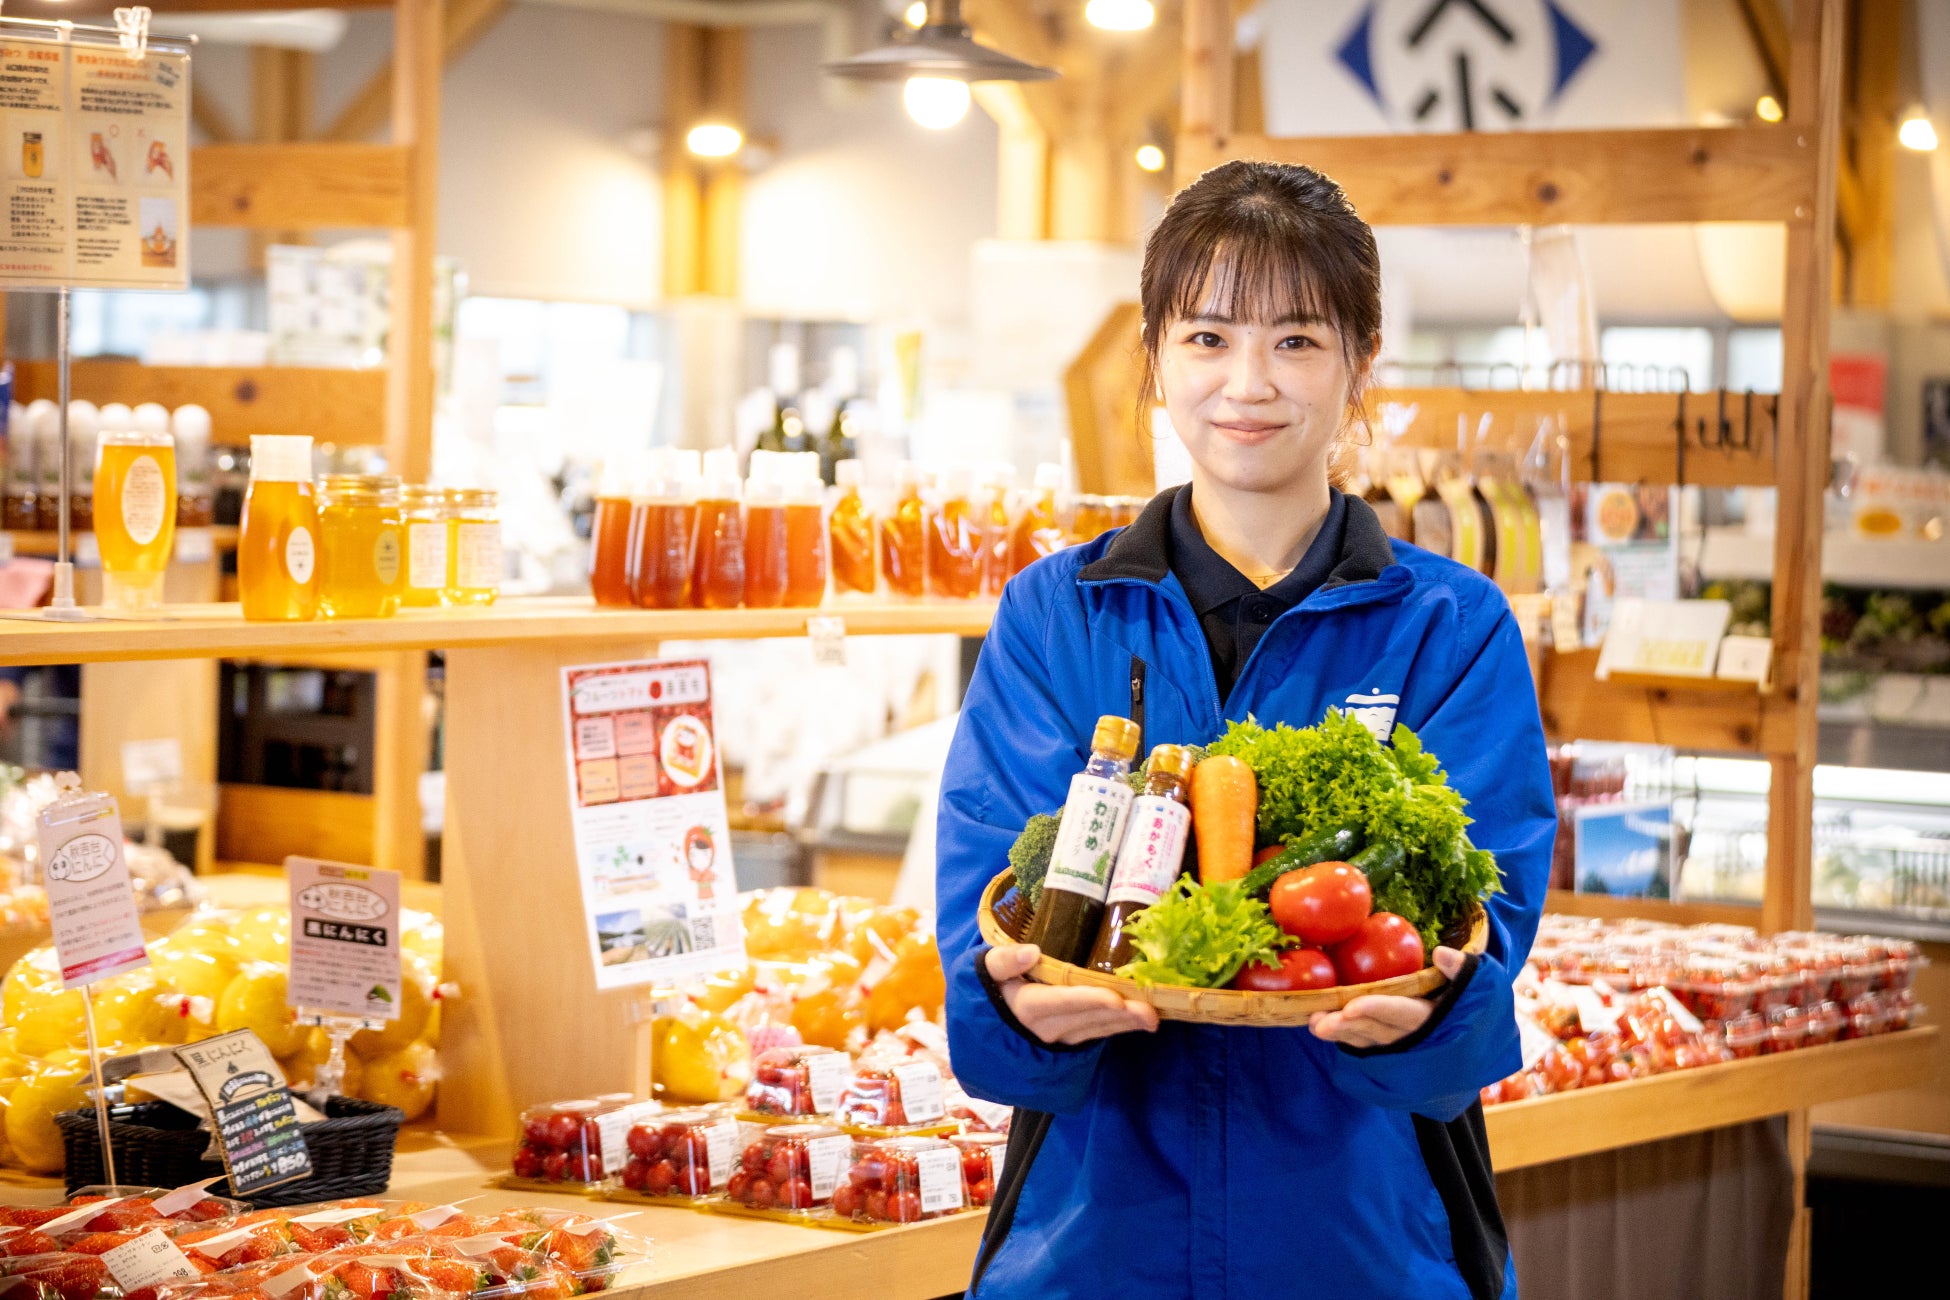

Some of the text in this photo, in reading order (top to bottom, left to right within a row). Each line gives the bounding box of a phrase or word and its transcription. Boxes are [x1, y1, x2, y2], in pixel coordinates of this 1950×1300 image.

[1084, 800, 1109, 851] わかめ
[1144, 816, 1165, 869] あかもく
[306, 920, 386, 945] 黒にんにく
